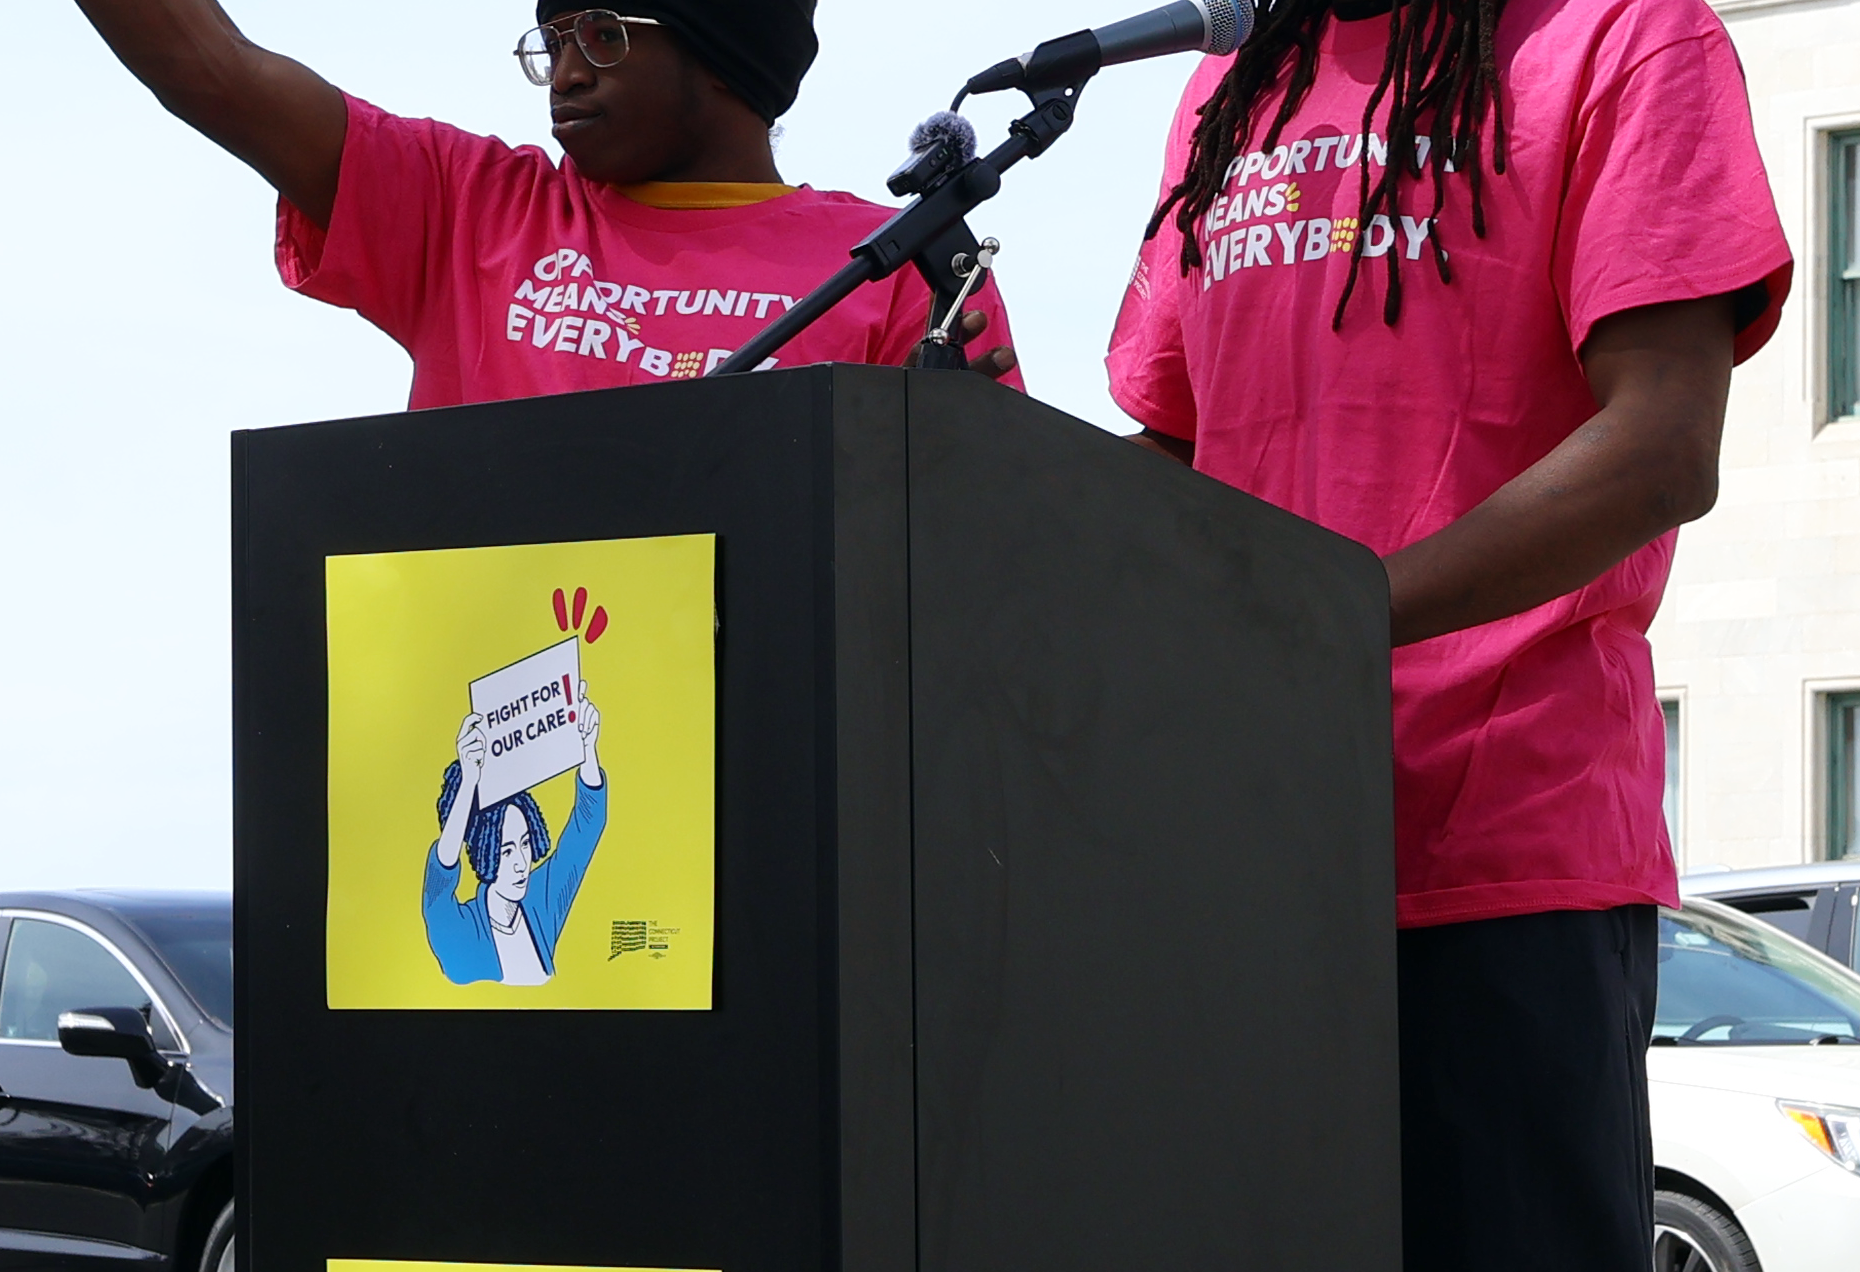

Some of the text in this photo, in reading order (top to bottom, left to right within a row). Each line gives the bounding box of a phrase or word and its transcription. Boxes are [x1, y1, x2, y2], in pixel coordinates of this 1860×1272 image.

[486, 694, 529, 729] FIGHT
[531, 680, 561, 708] FOR
[491, 729, 525, 757] OUR
